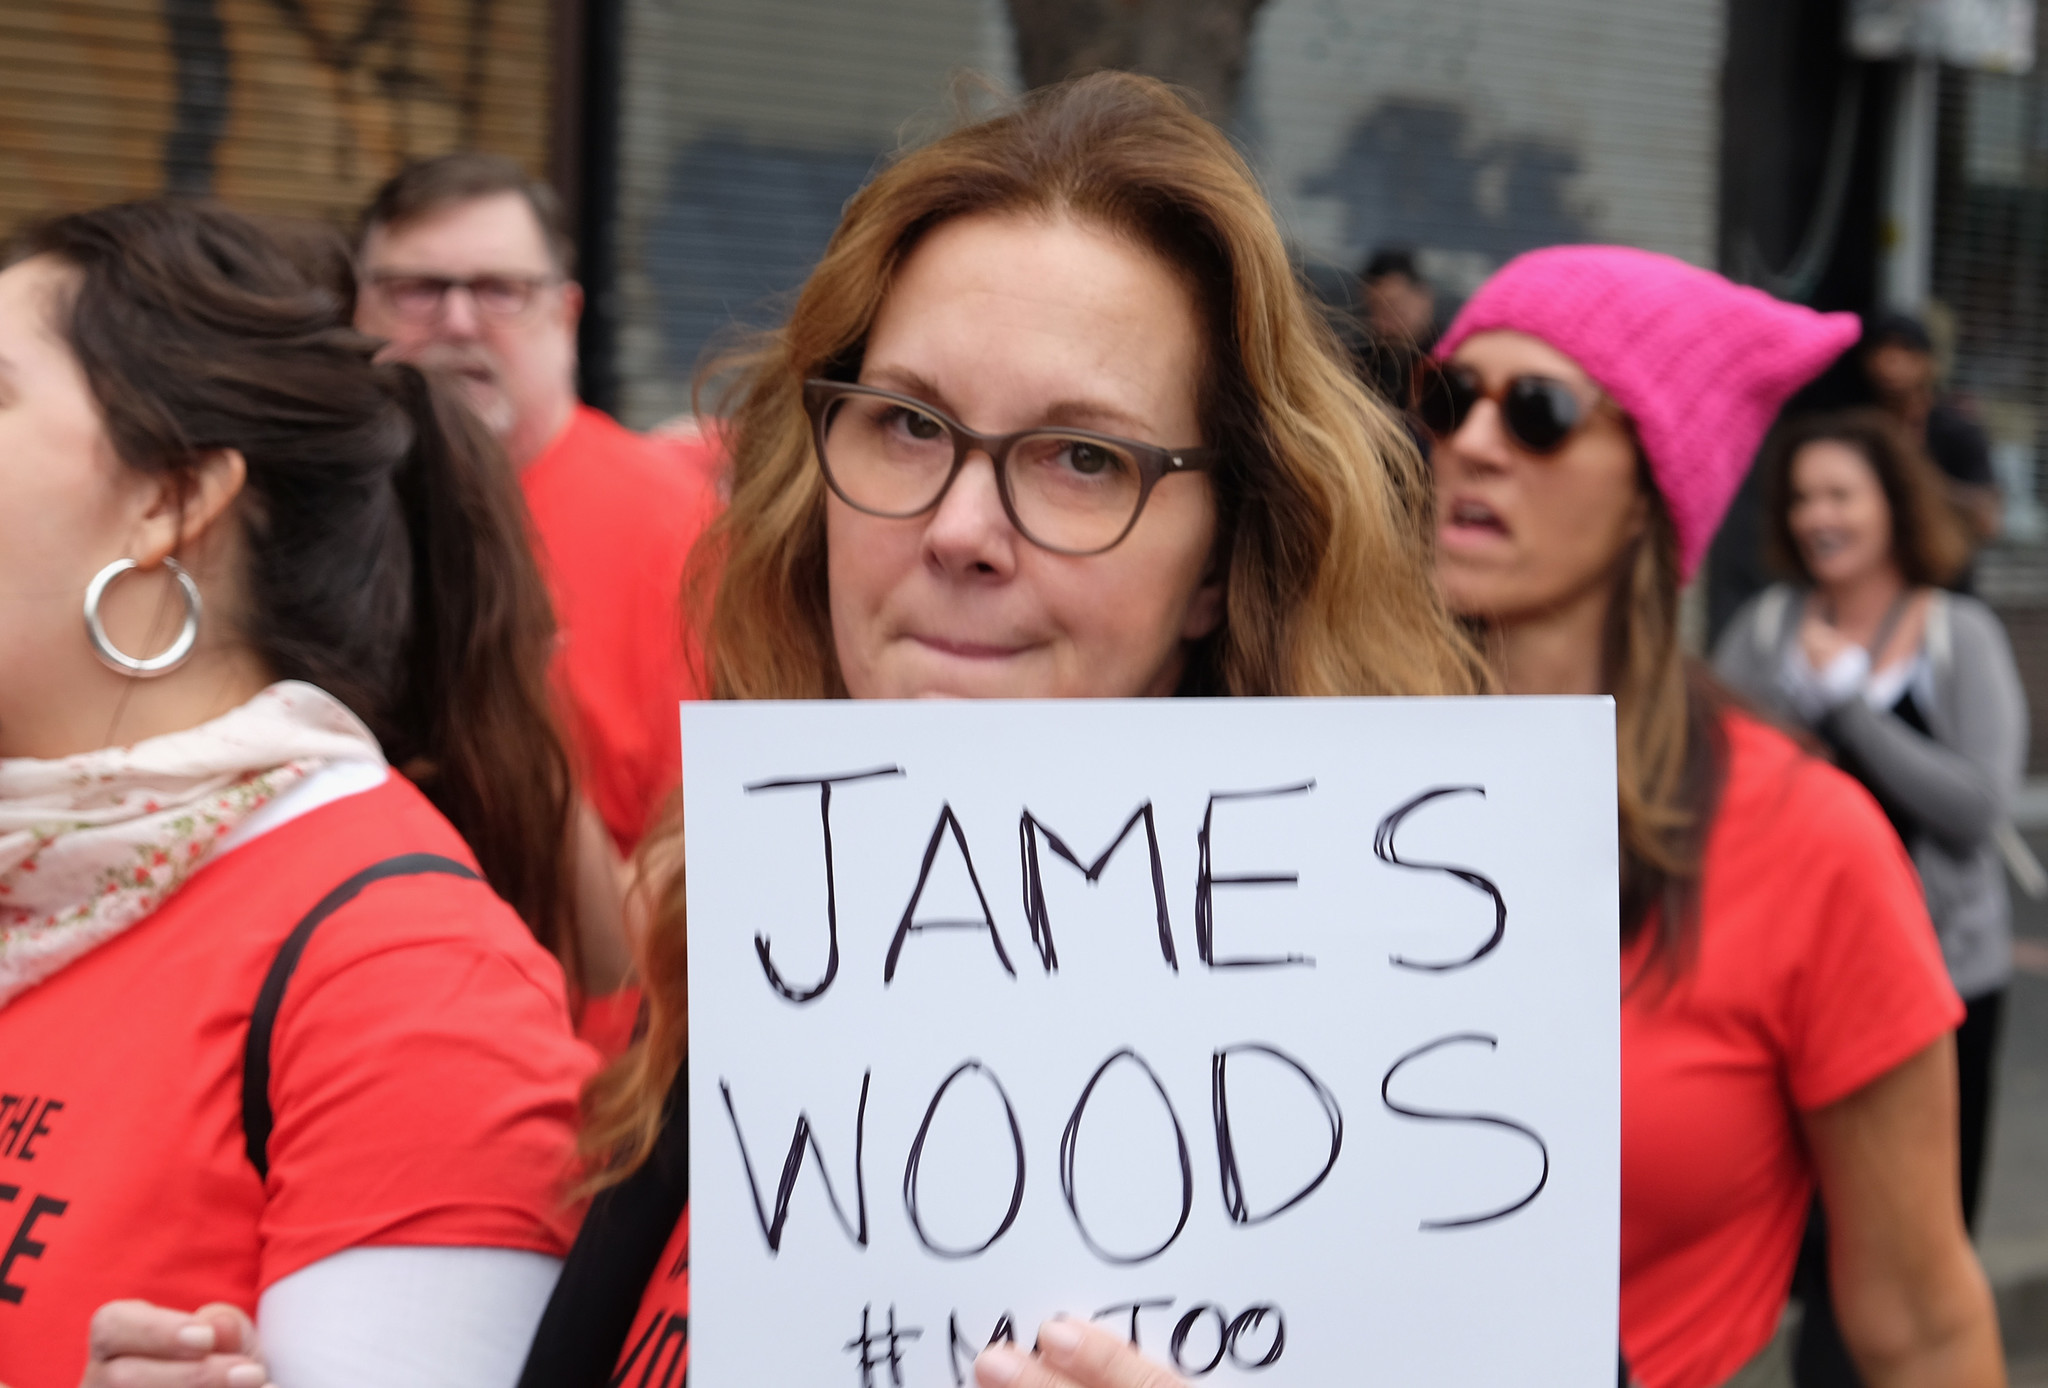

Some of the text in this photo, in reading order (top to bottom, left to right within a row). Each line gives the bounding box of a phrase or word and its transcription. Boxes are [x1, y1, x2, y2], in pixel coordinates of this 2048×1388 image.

[743, 763, 1508, 1005] JAMES
[718, 1032, 1549, 1265] WOODS
[842, 1296, 1287, 1388] #MTOO
